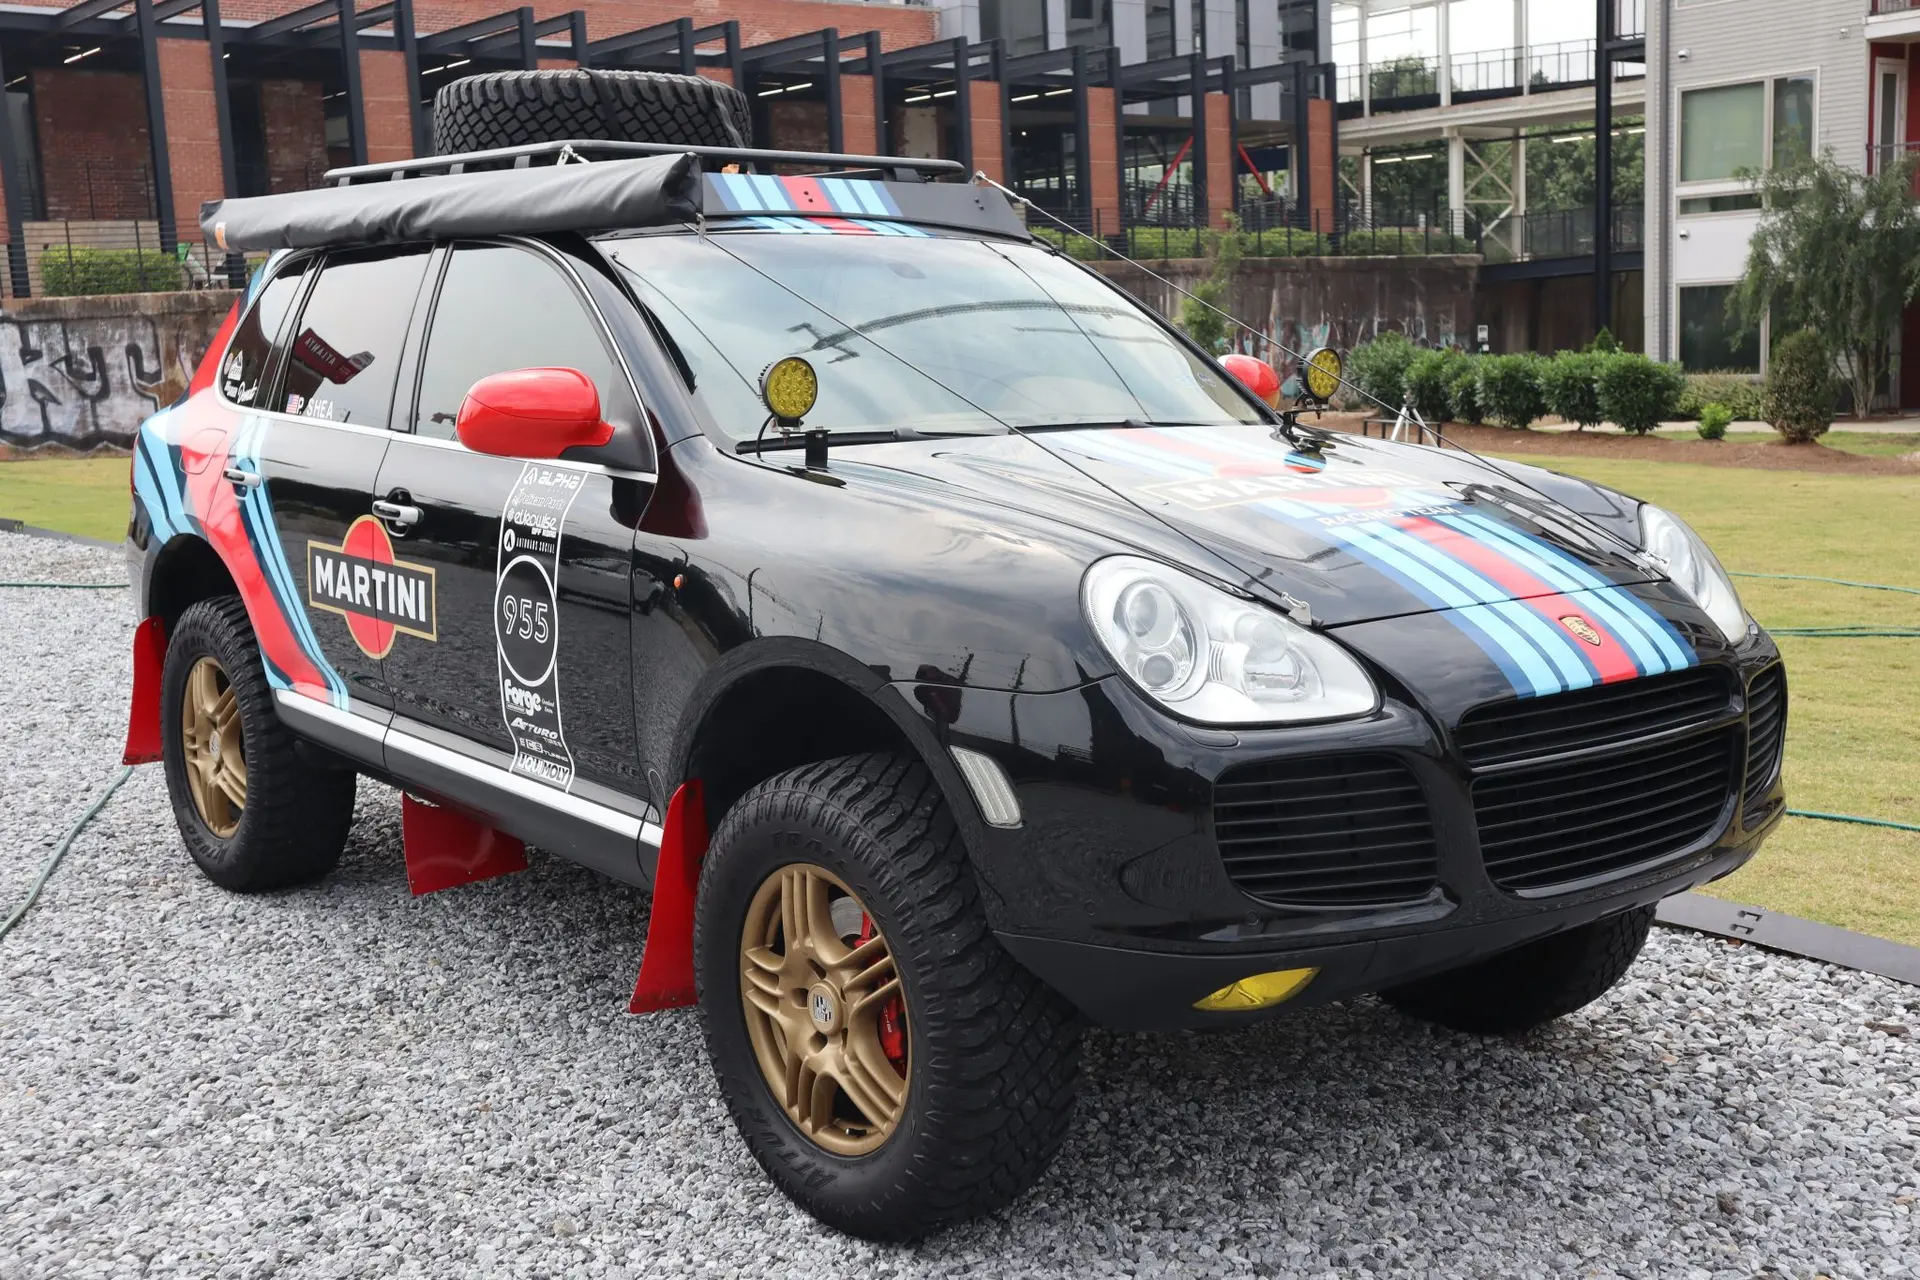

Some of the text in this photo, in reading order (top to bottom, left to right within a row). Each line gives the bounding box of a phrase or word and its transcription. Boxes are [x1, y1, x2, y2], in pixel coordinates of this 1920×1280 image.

[307, 398, 333, 419] SHEA
[538, 470, 581, 489] ALPHA
[1316, 505, 1462, 526] RACING TEAM
[315, 554, 426, 622] MARTINI
[503, 594, 549, 644] 955
[504, 678, 541, 716] Forge
[543, 761, 569, 782] MOLY
